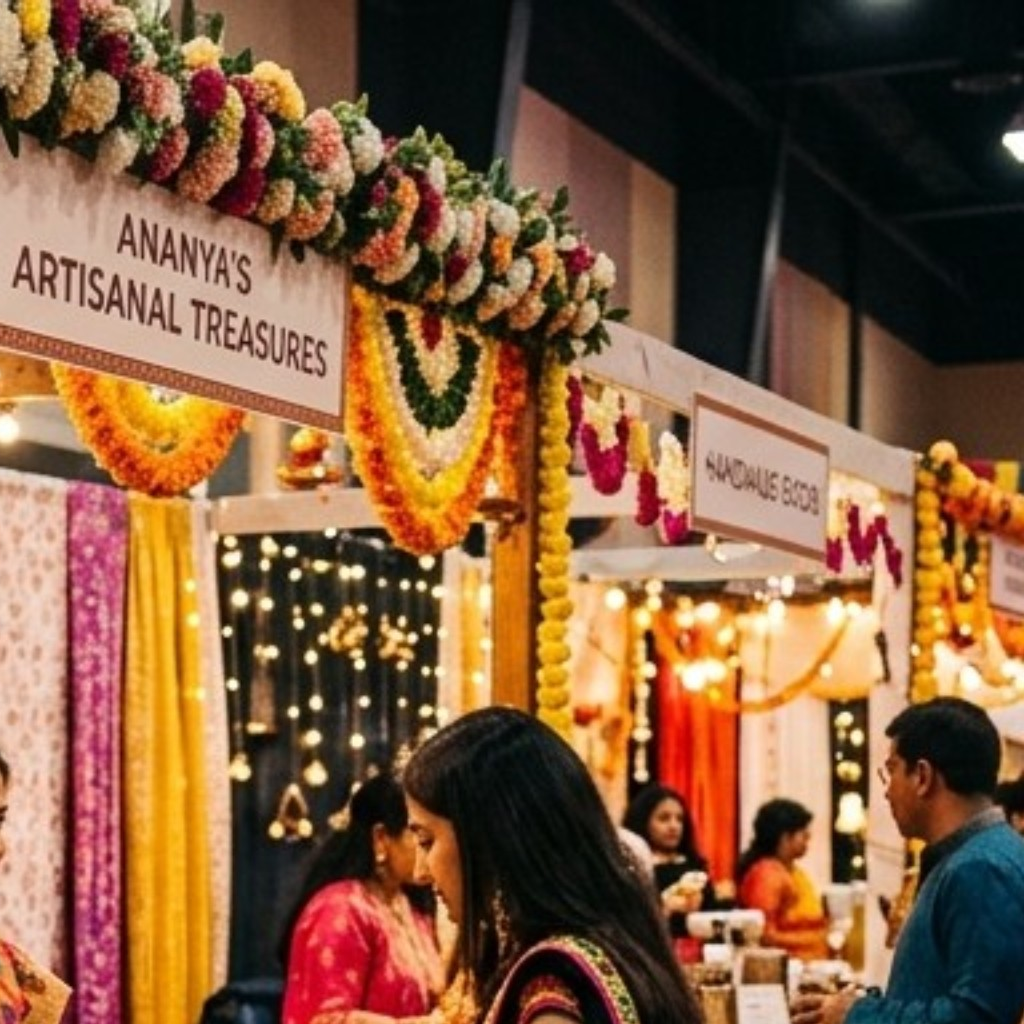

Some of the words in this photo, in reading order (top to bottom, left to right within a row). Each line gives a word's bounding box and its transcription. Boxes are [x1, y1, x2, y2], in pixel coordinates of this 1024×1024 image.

[117, 213, 252, 295] ANANYA'S
[12, 245, 182, 336] ARTISANAL
[191, 298, 328, 378] TREASURES
